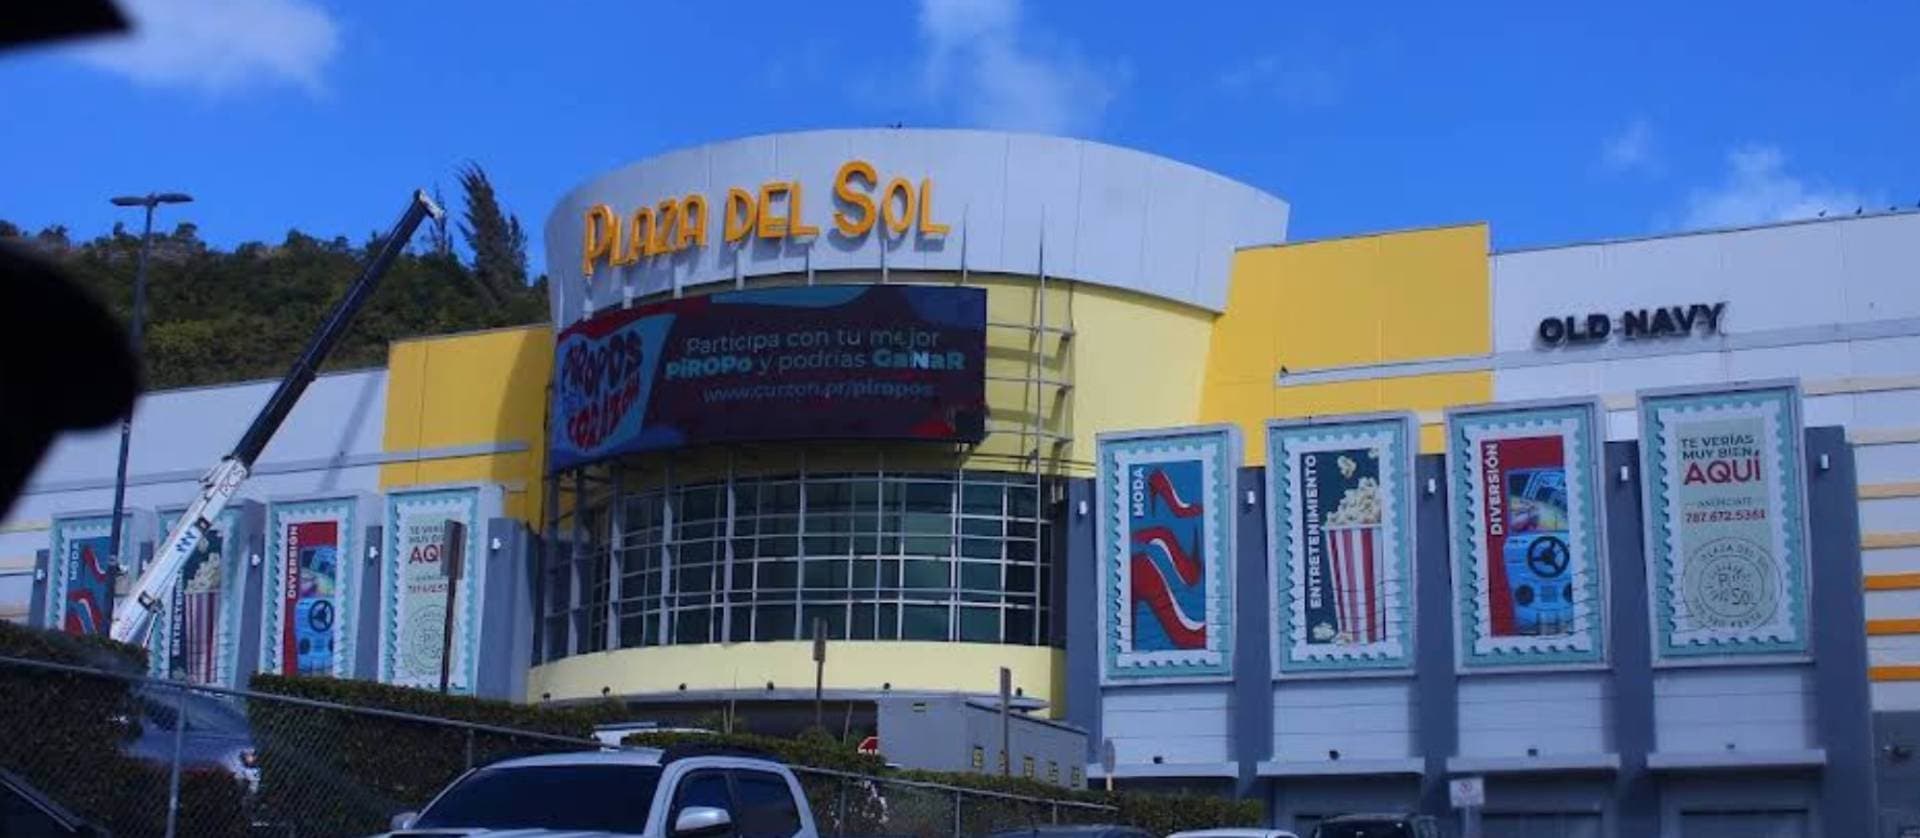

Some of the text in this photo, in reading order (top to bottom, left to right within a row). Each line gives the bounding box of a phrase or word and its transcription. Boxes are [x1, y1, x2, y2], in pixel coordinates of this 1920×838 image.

[686, 327, 941, 354] Participa con tu mejor
[1539, 302, 1726, 343] OLD NAVY
[758, 354, 773, 376] y
[1681, 437, 1699, 449] TE
[1683, 446, 1753, 461] MUY BIEN
[1683, 449, 1761, 486] AQUÍ
[1131, 466, 1146, 517] MODA
[1485, 442, 1504, 536] DIVERSIÓN
[1306, 454, 1324, 609] ENTRETENIMIENTO
